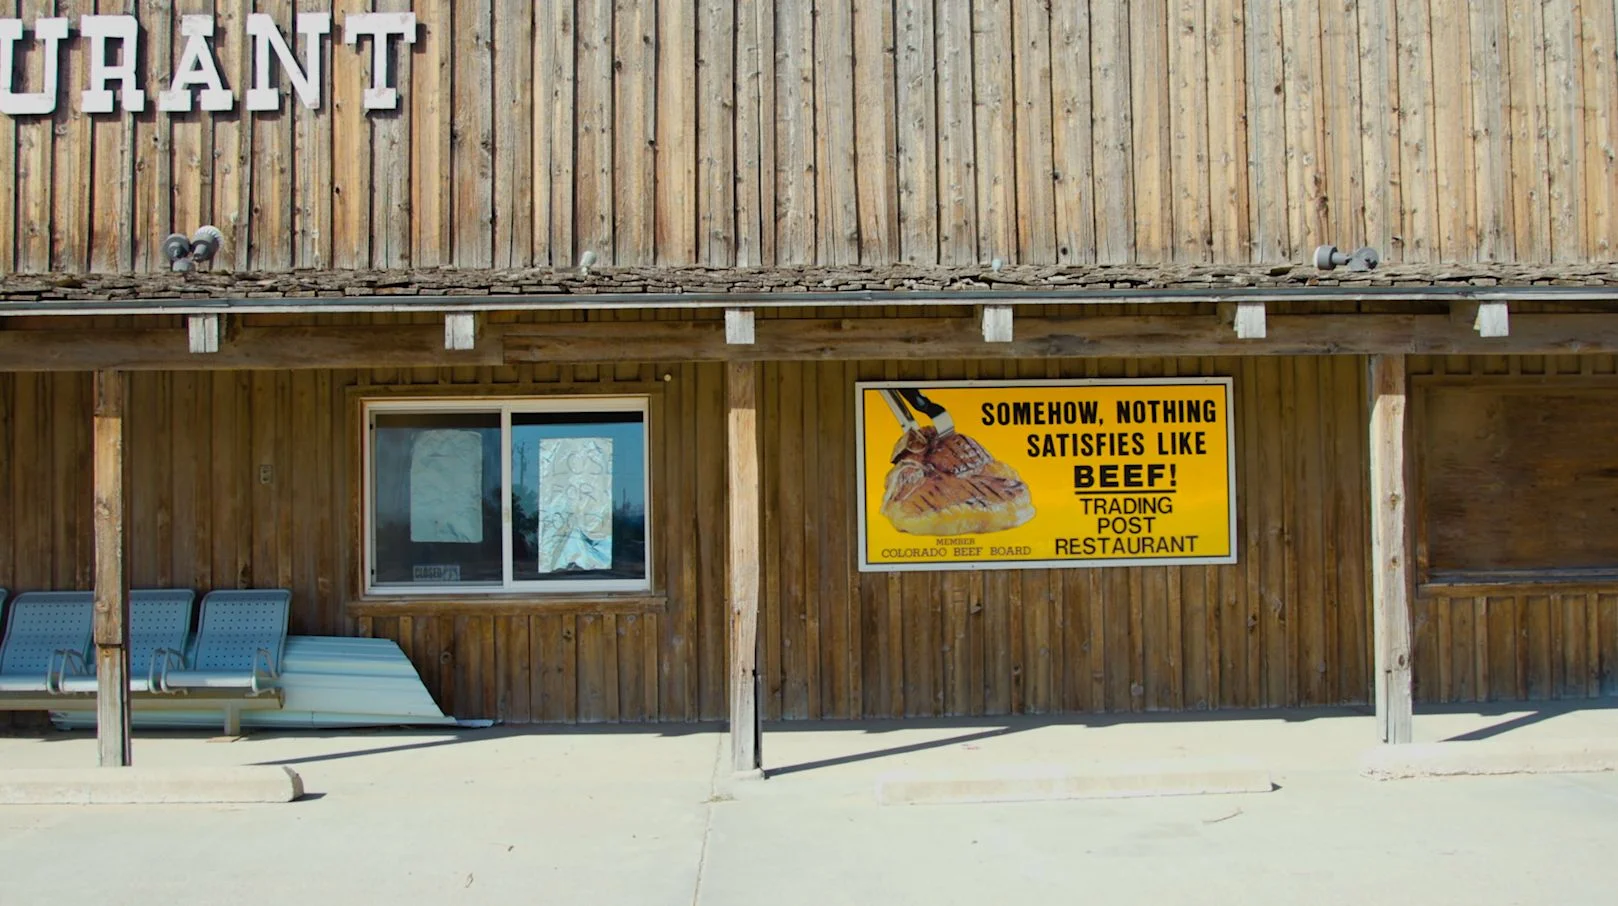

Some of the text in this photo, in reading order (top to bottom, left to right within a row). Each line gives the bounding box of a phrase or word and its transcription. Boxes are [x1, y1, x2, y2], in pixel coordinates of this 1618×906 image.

[0, 12, 416, 115] URANT
[982, 400, 1215, 425] SOMEHOW, NOTHING
[1028, 432, 1206, 457] SATISFIES LIKE
[1074, 464, 1176, 488] BEEF!
[1080, 497, 1172, 514] TRADING
[1098, 517, 1156, 534] POST
[881, 546, 1031, 558] COLORADO BEEF BOARD
[1056, 536, 1198, 555] RESTAURANT
